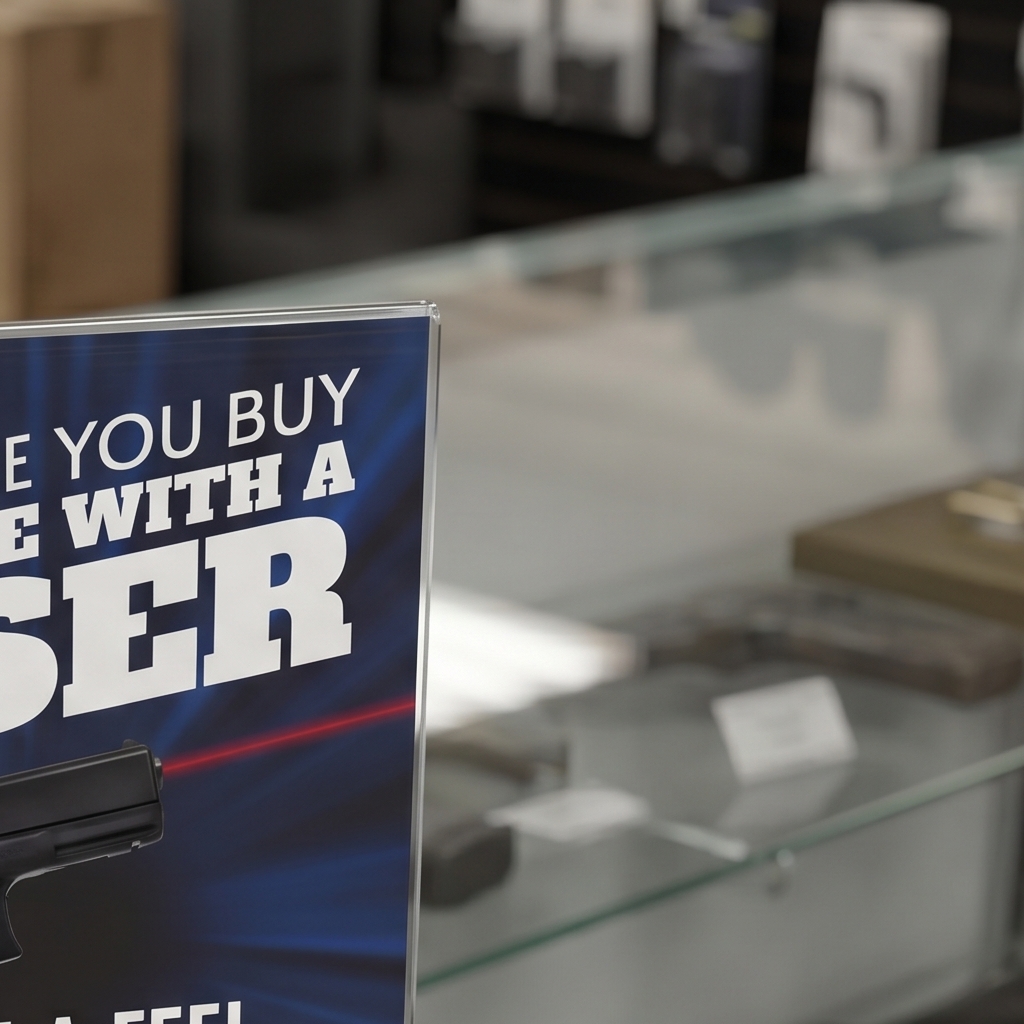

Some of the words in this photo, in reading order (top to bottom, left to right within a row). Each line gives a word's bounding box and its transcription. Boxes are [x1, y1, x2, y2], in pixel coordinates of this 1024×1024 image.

[54, 400, 202, 480] YOU
[229, 368, 361, 448] BUY
[62, 453, 283, 549] WITH
[303, 440, 356, 501] A
